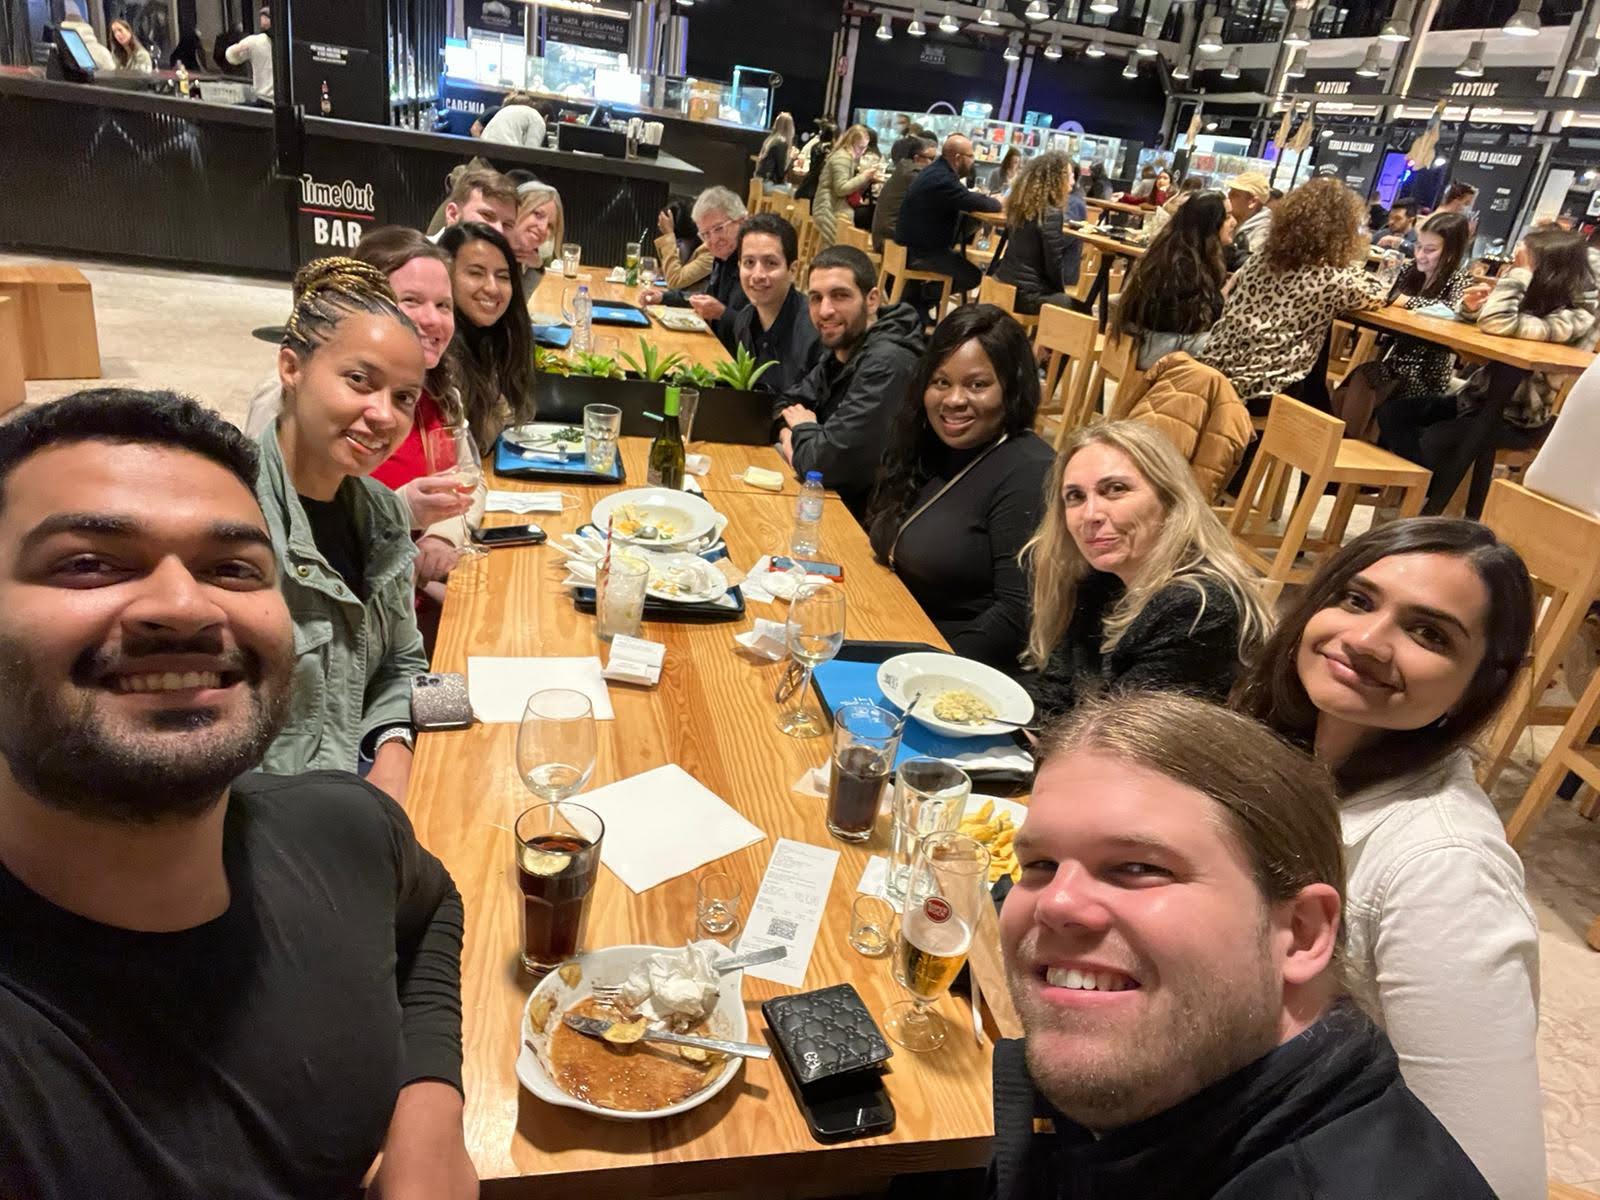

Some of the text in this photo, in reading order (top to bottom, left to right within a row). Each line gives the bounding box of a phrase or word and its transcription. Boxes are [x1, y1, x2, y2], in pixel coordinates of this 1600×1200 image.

[443, 97, 485, 114] CADEMIA
[1459, 150, 1480, 162] TERRA
[314, 216, 362, 248] BAR
